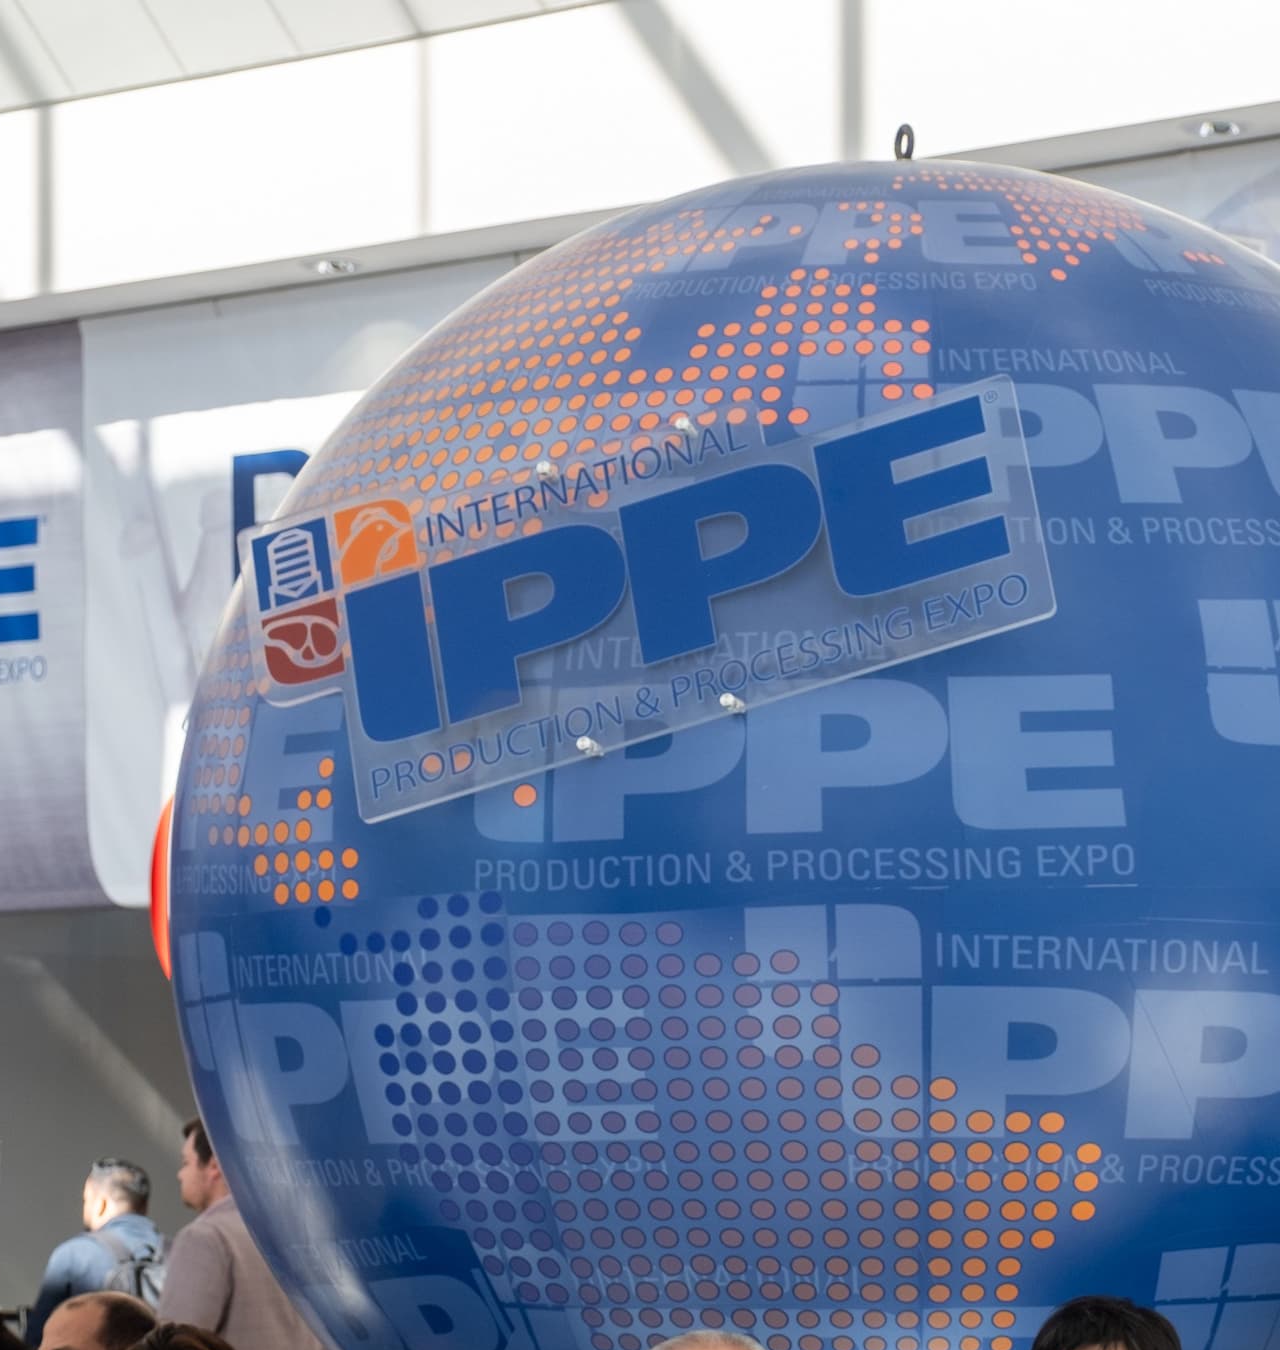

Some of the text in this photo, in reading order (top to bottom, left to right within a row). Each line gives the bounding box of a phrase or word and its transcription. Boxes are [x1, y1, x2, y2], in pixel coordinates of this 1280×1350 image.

[973, 271, 1039, 293] EXPO
[937, 344, 1187, 377] INTERNATIONAL
[426, 418, 750, 548] INTERNATIONAL
[1107, 517, 1133, 547] &
[345, 394, 1012, 743] IPPE
[371, 573, 1030, 800] PRODUCTION & PROCESSING EXPO
[475, 843, 1136, 893] PRODUCTION & PROCESSING EXPO
[936, 931, 1270, 975] INTERNATIONAL
[1099, 1153, 1126, 1183] &
